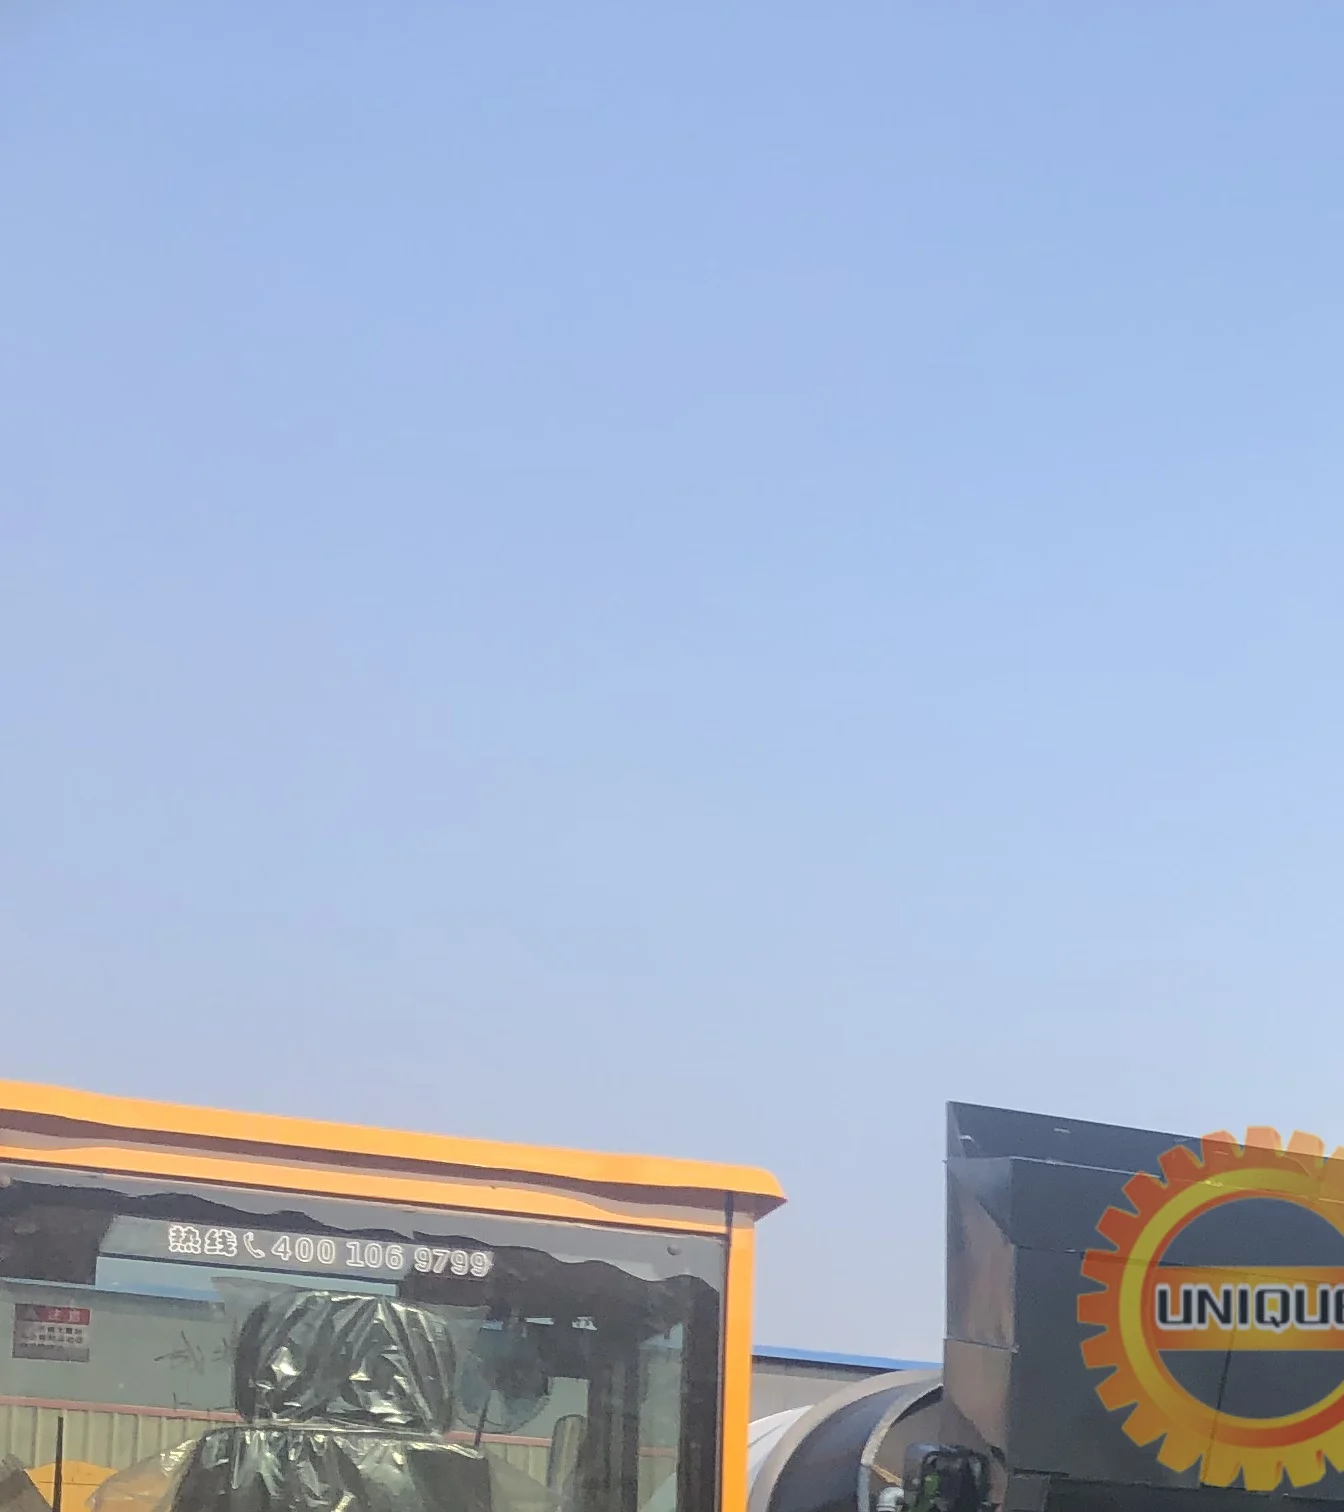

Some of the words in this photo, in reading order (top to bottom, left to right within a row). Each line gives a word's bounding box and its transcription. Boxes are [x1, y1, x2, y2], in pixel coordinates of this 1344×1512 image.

[168, 1224, 238, 1257] 热线
[271, 1235, 336, 1265] 400
[345, 1240, 405, 1270] 106
[412, 1246, 492, 1279] 9799
